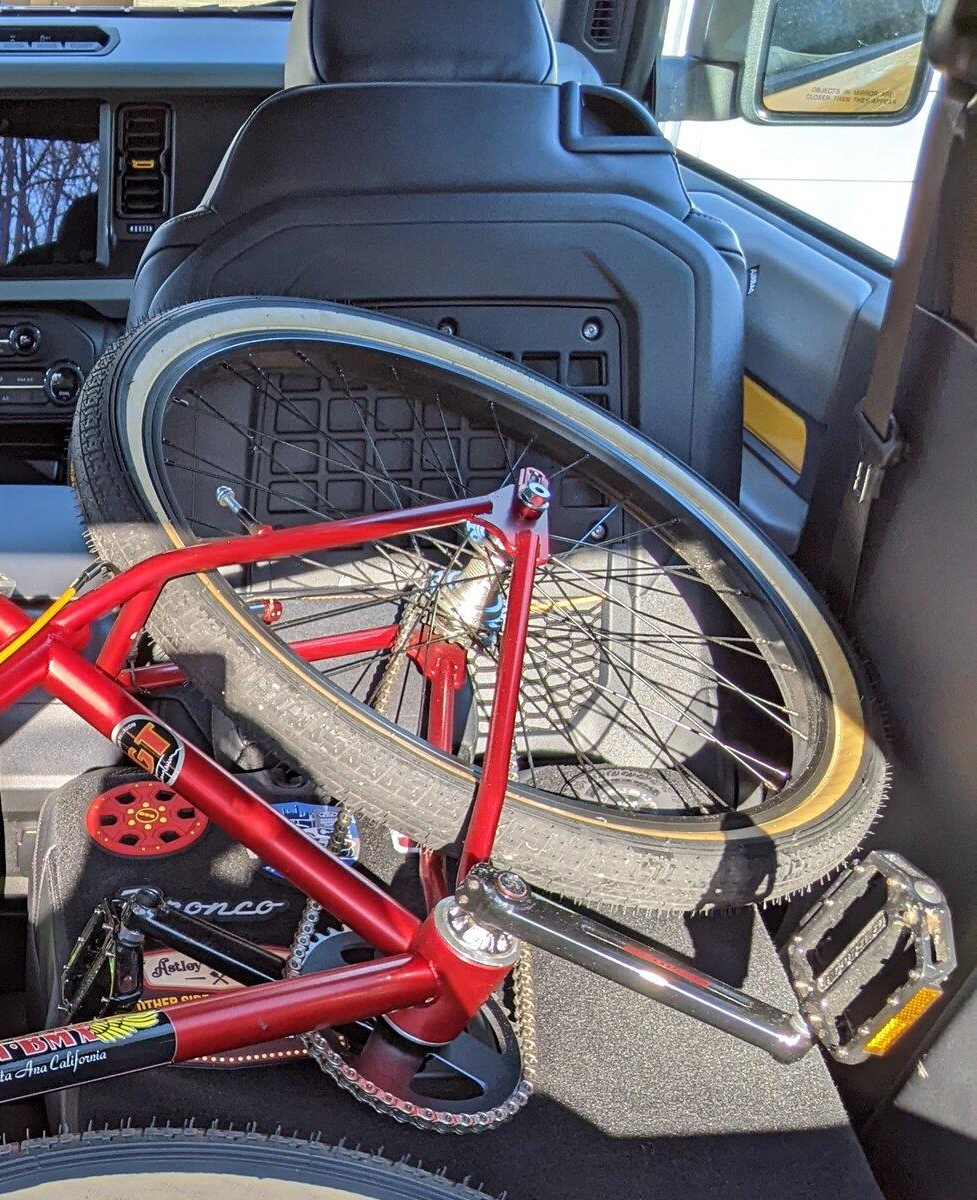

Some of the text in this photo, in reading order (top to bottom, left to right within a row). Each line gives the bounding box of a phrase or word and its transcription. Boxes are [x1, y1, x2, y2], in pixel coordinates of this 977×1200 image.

[806, 93, 830, 101] CLOSER
[127, 722, 171, 774] GT
[152, 957, 202, 978] Astley
[14, 1060, 48, 1079] Ana
[49, 1049, 108, 1073] California
